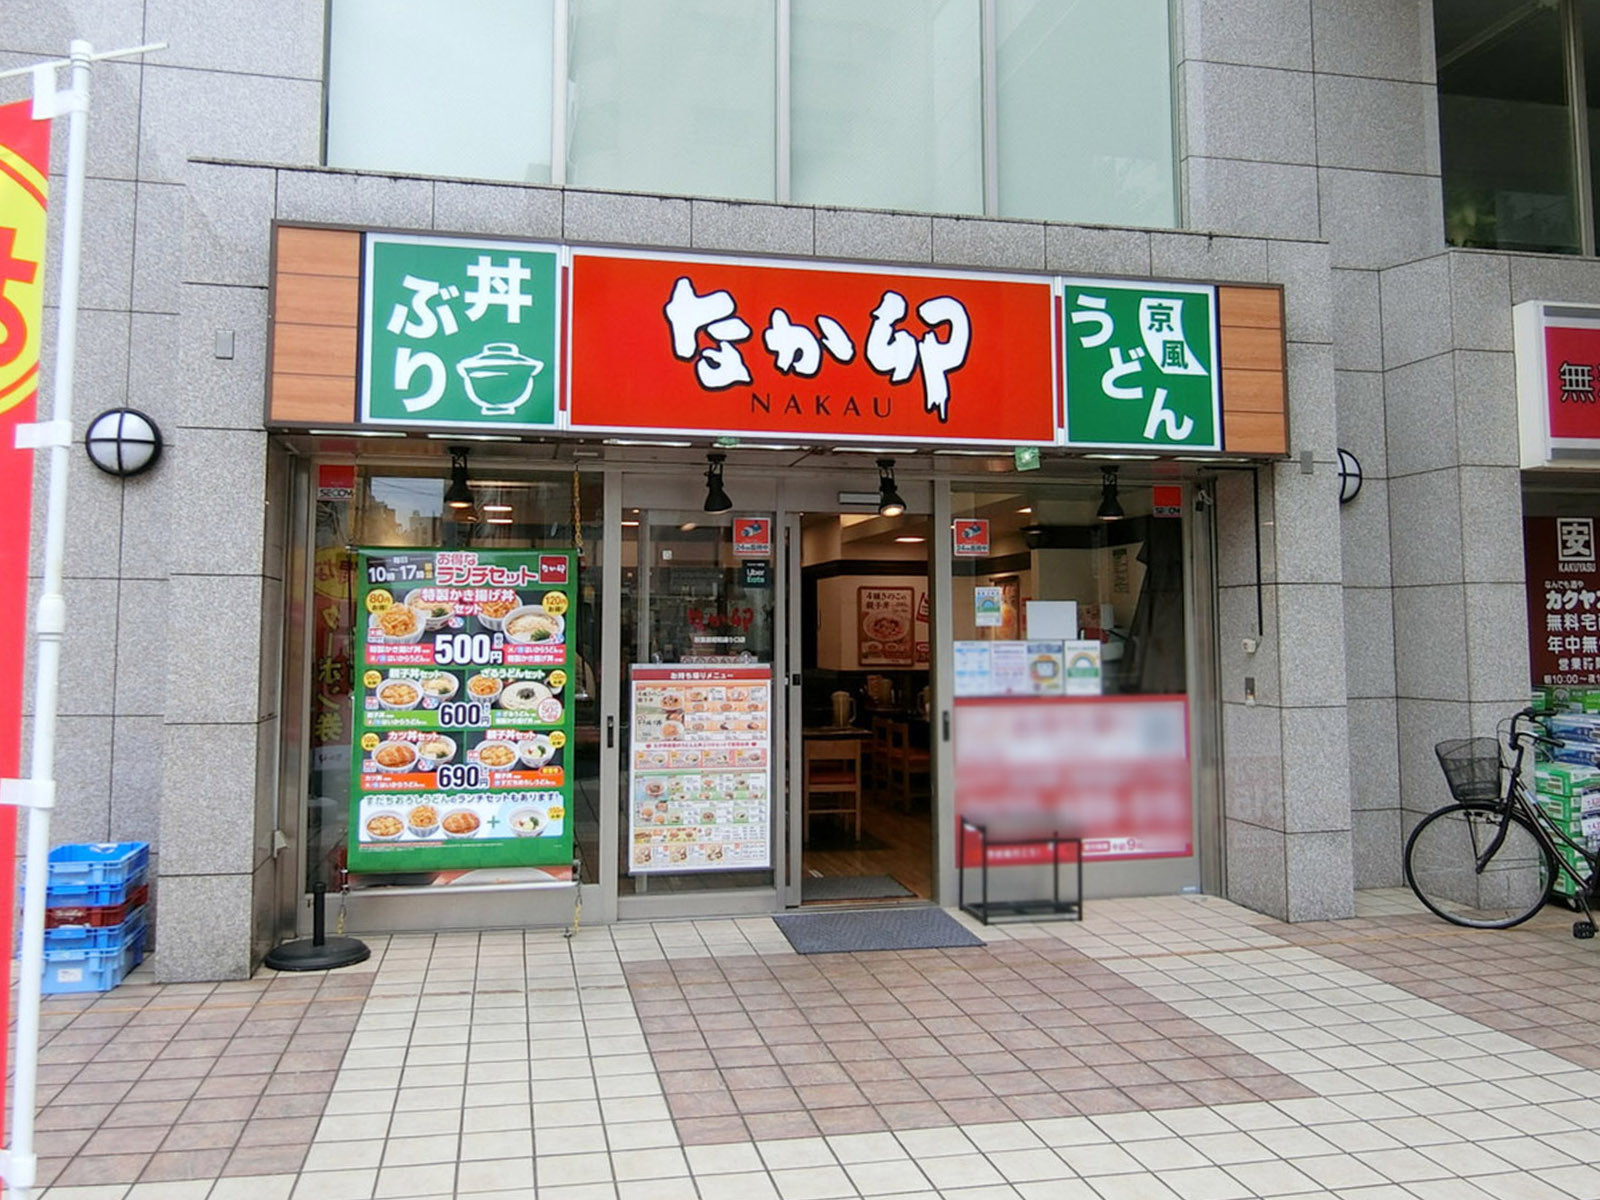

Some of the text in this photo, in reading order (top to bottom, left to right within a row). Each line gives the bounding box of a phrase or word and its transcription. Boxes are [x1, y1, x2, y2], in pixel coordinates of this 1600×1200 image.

[1146, 302, 1189, 370] 京風
[663, 276, 972, 423] なか卯
[1070, 293, 1195, 441] うどん
[1560, 362, 1600, 403] 無
[751, 392, 893, 418] NAKAU
[1561, 522, 1592, 557] 安
[437, 553, 477, 566] お得な
[1558, 563, 1596, 572] KAKUYASU
[437, 565, 538, 586] ランチセット
[746, 568, 765, 577] Uber
[453, 603, 483, 614] セット
[1546, 613, 1600, 632] 無料宅
[434, 632, 503, 664] 500円
[1547, 635, 1600, 655] 年中無
